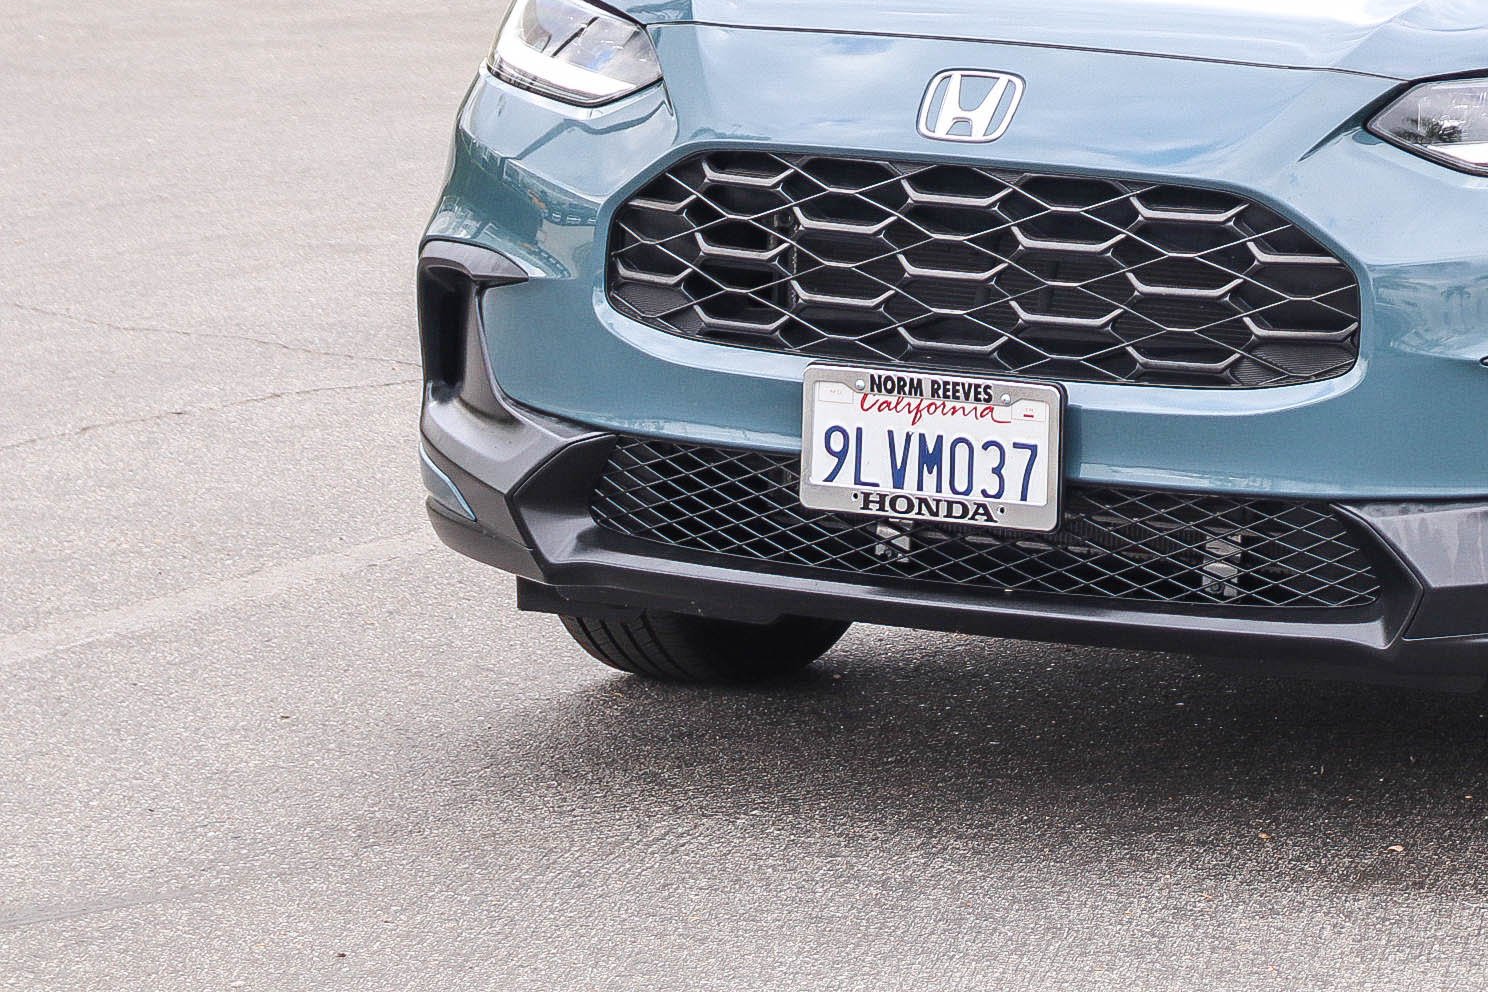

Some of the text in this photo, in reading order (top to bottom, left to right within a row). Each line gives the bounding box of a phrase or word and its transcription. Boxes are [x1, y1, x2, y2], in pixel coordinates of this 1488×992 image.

[869, 373, 993, 404] NORM REEVES
[860, 392, 1012, 426] California
[822, 424, 1039, 502] 9LVM037
[859, 491, 999, 524] HONDA
